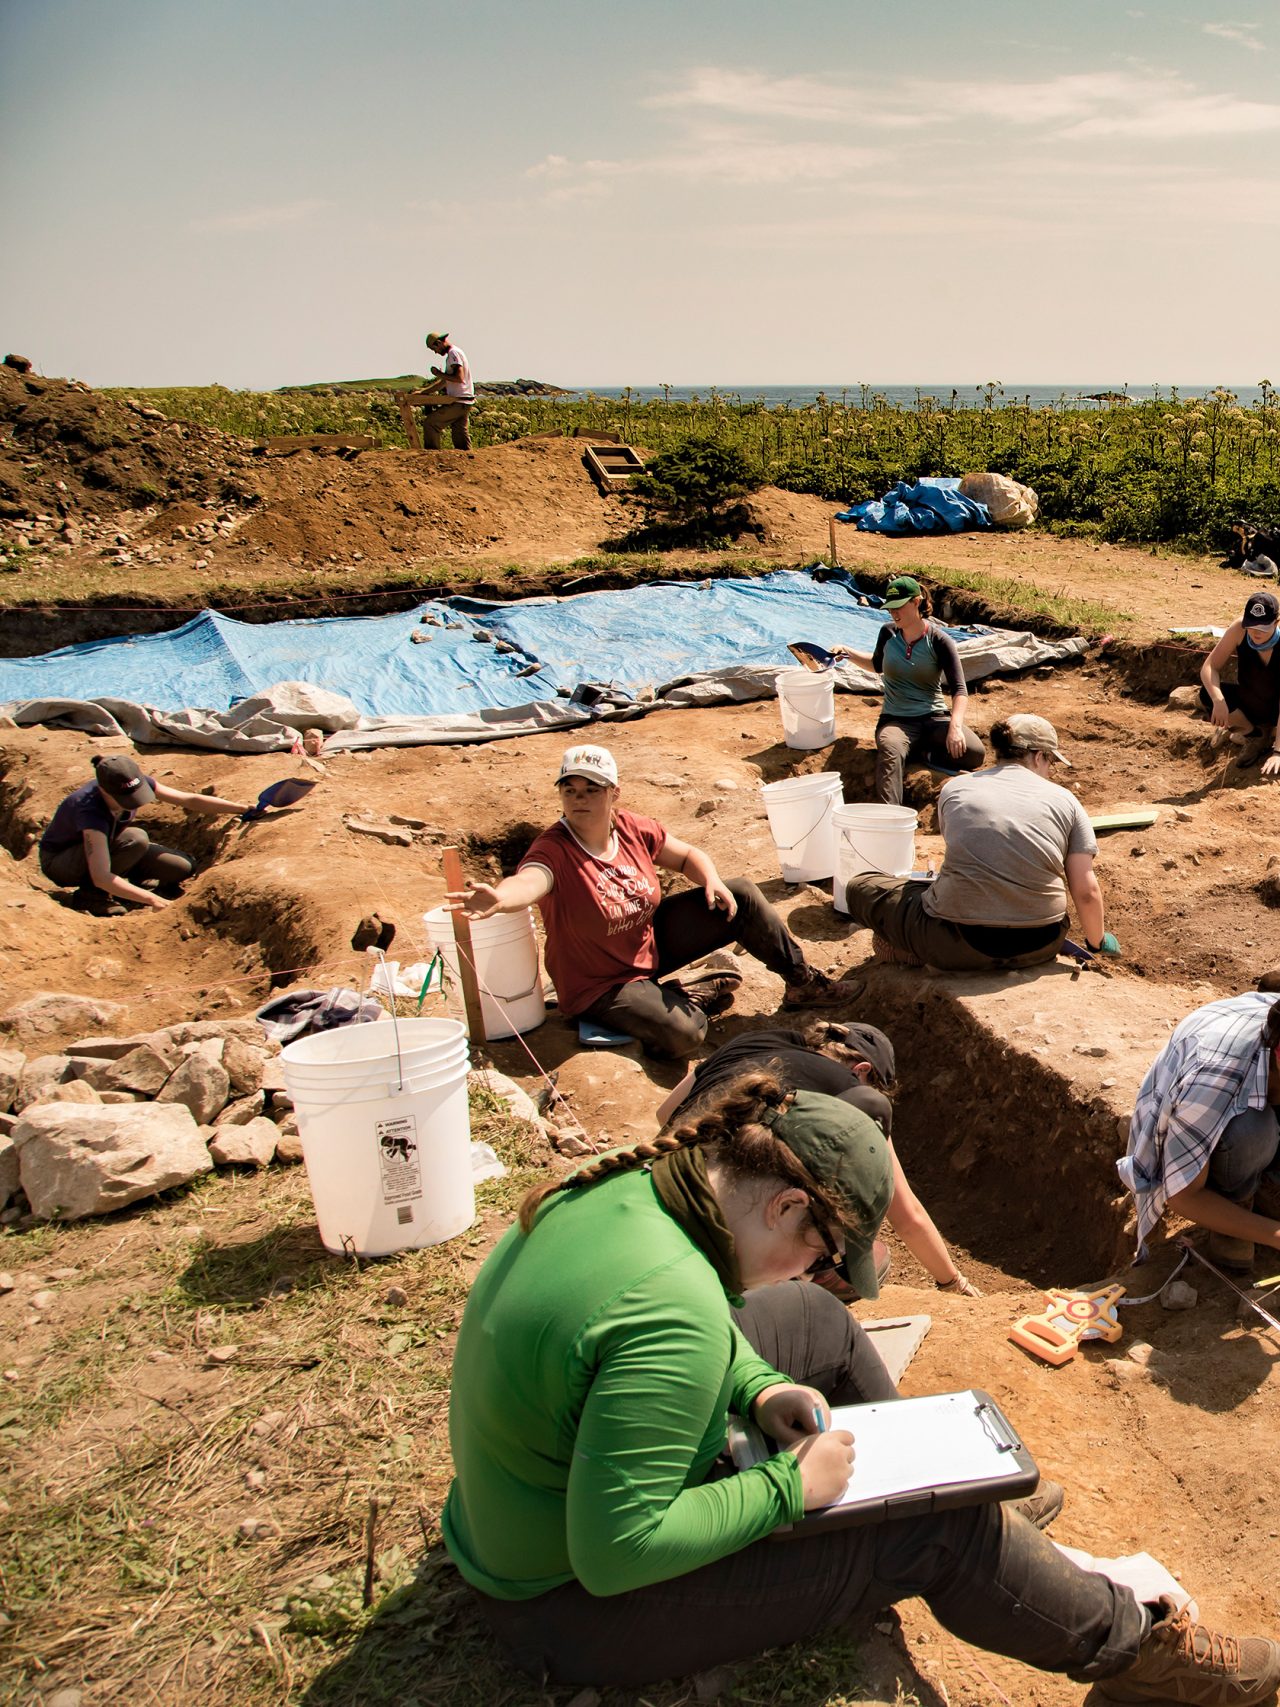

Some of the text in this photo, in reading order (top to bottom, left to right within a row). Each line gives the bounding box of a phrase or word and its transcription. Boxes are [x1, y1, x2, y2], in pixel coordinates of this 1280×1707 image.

[609, 904, 623, 919] CAN
[624, 899, 642, 916] HAVE
[386, 1125, 411, 1134] ATTENTION
